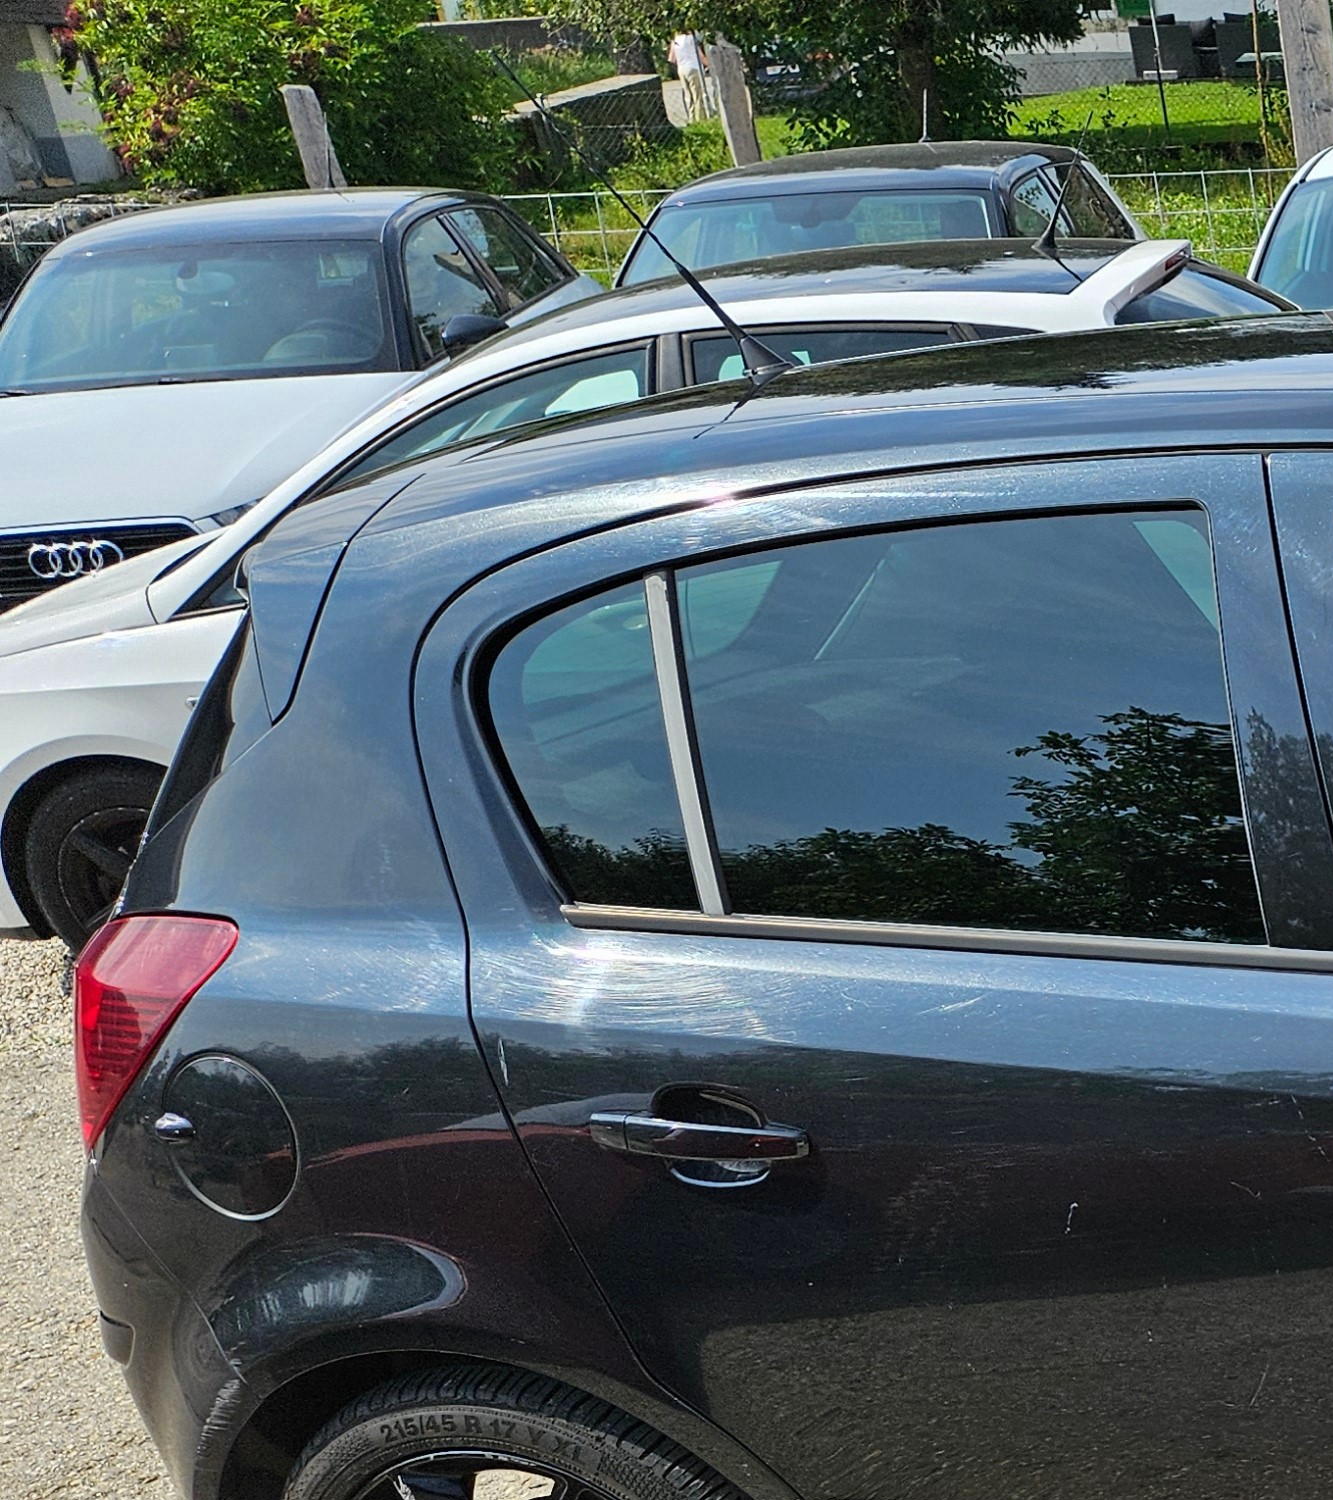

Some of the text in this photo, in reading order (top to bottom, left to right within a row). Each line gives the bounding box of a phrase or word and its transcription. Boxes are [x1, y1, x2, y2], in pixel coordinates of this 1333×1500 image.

[380, 1414, 457, 1443] 215/45
[463, 1415, 483, 1434] R
[490, 1419, 517, 1438] 17
